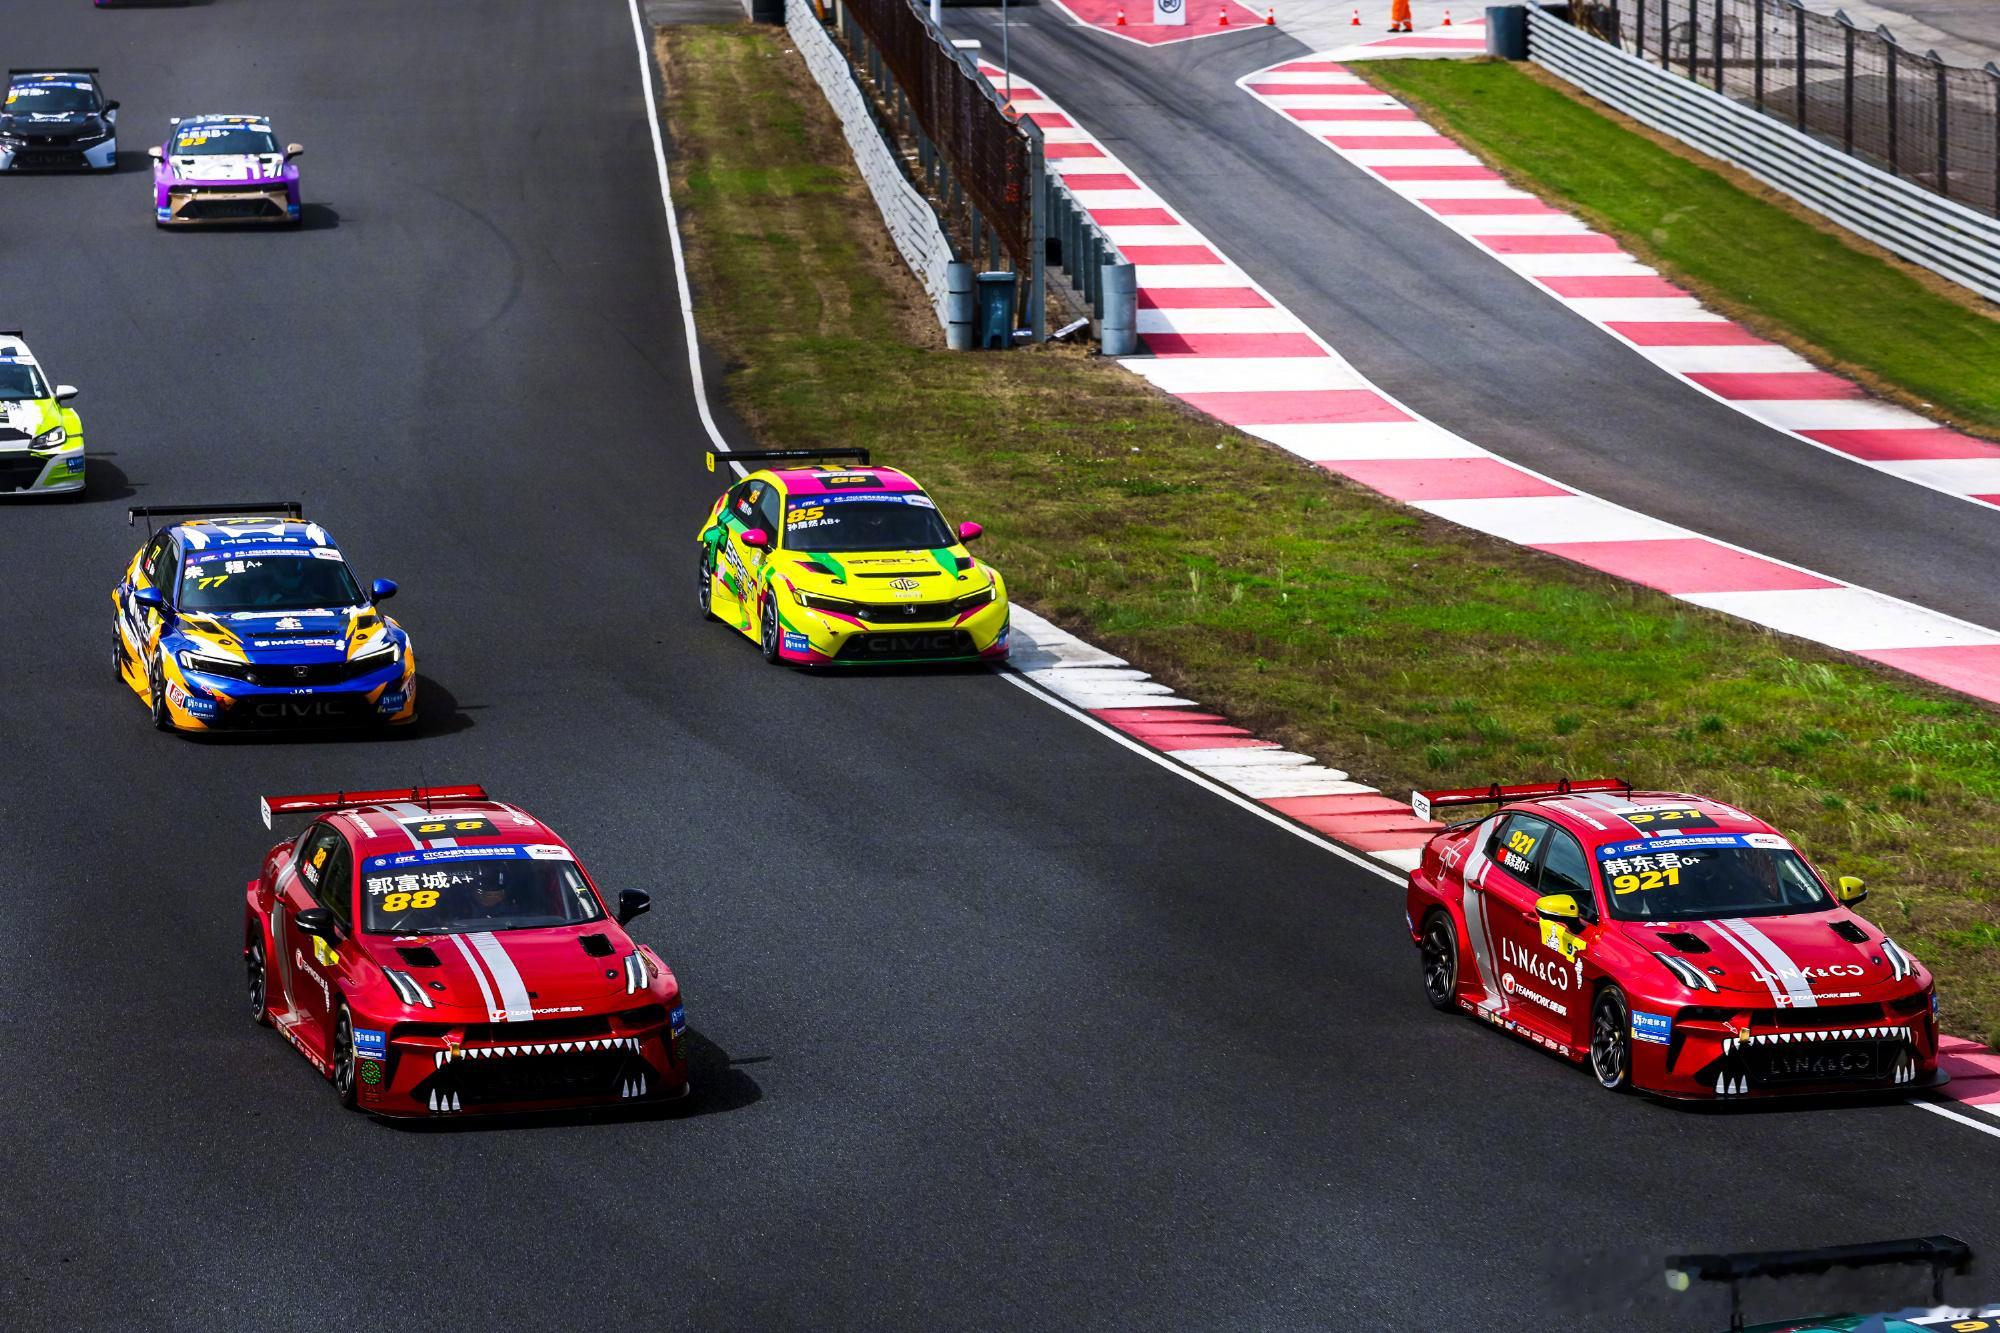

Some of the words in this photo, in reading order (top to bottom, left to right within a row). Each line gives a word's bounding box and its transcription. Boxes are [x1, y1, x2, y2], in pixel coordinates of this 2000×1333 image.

[787, 506, 825, 523] 85
[197, 575, 229, 590] 77
[868, 635, 951, 652] CIVIC
[255, 701, 347, 718] CIVIC
[1627, 809, 1702, 825] 921
[418, 820, 484, 834] 88
[1508, 831, 1536, 856] 921
[1603, 852, 1683, 878] 韩东君
[367, 871, 451, 896] 郭富城
[1612, 867, 1681, 895] 921
[382, 890, 440, 913] 88
[1750, 964, 1865, 982] LYNK&CO
[1515, 983, 1551, 1008] TEAMWORK
[1794, 992, 1840, 1001] TEAMWORK
[510, 1007, 560, 1016] TEAMWORK
[1771, 1053, 1870, 1075] LYNK&CO
